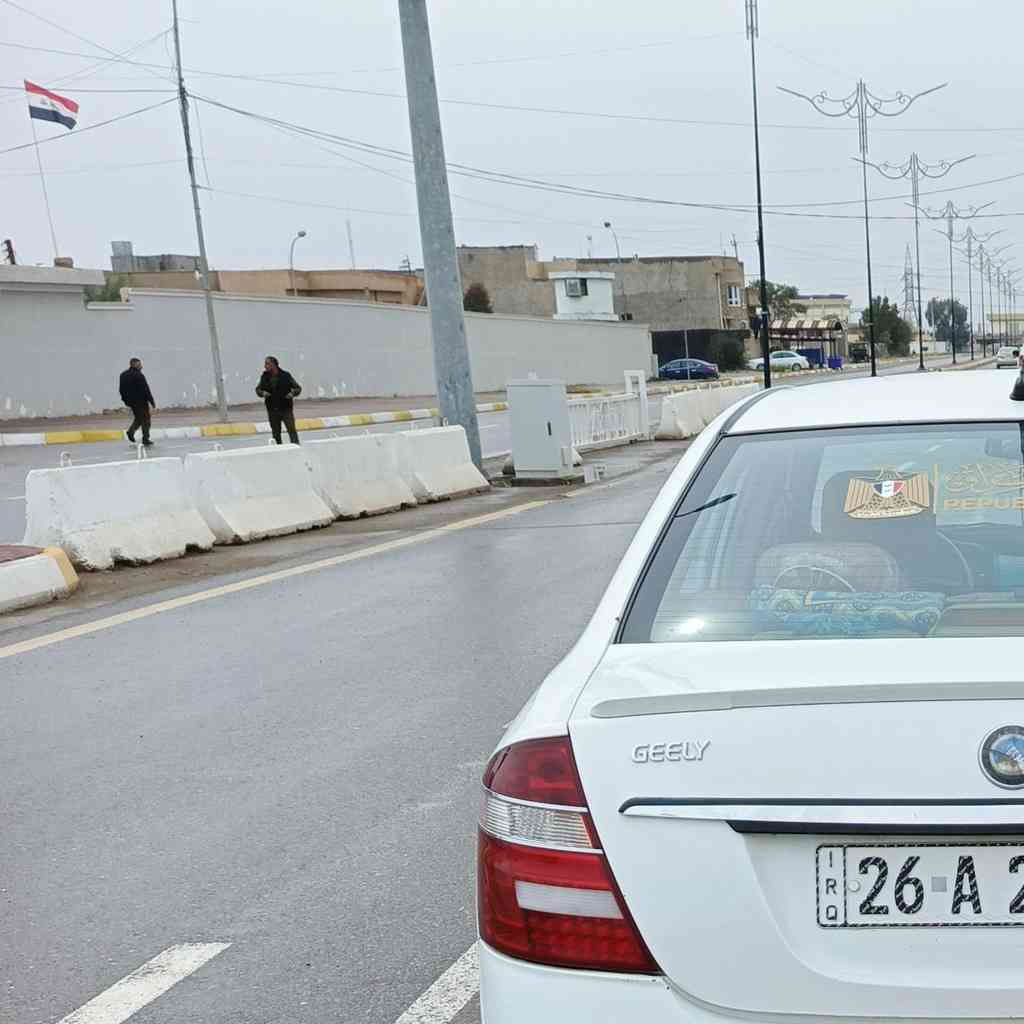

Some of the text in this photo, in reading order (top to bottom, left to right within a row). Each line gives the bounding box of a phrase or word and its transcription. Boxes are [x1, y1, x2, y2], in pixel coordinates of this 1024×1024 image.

[631, 741, 711, 763] GEELY
[859, 856, 924, 914] 26
[951, 856, 982, 914] A
